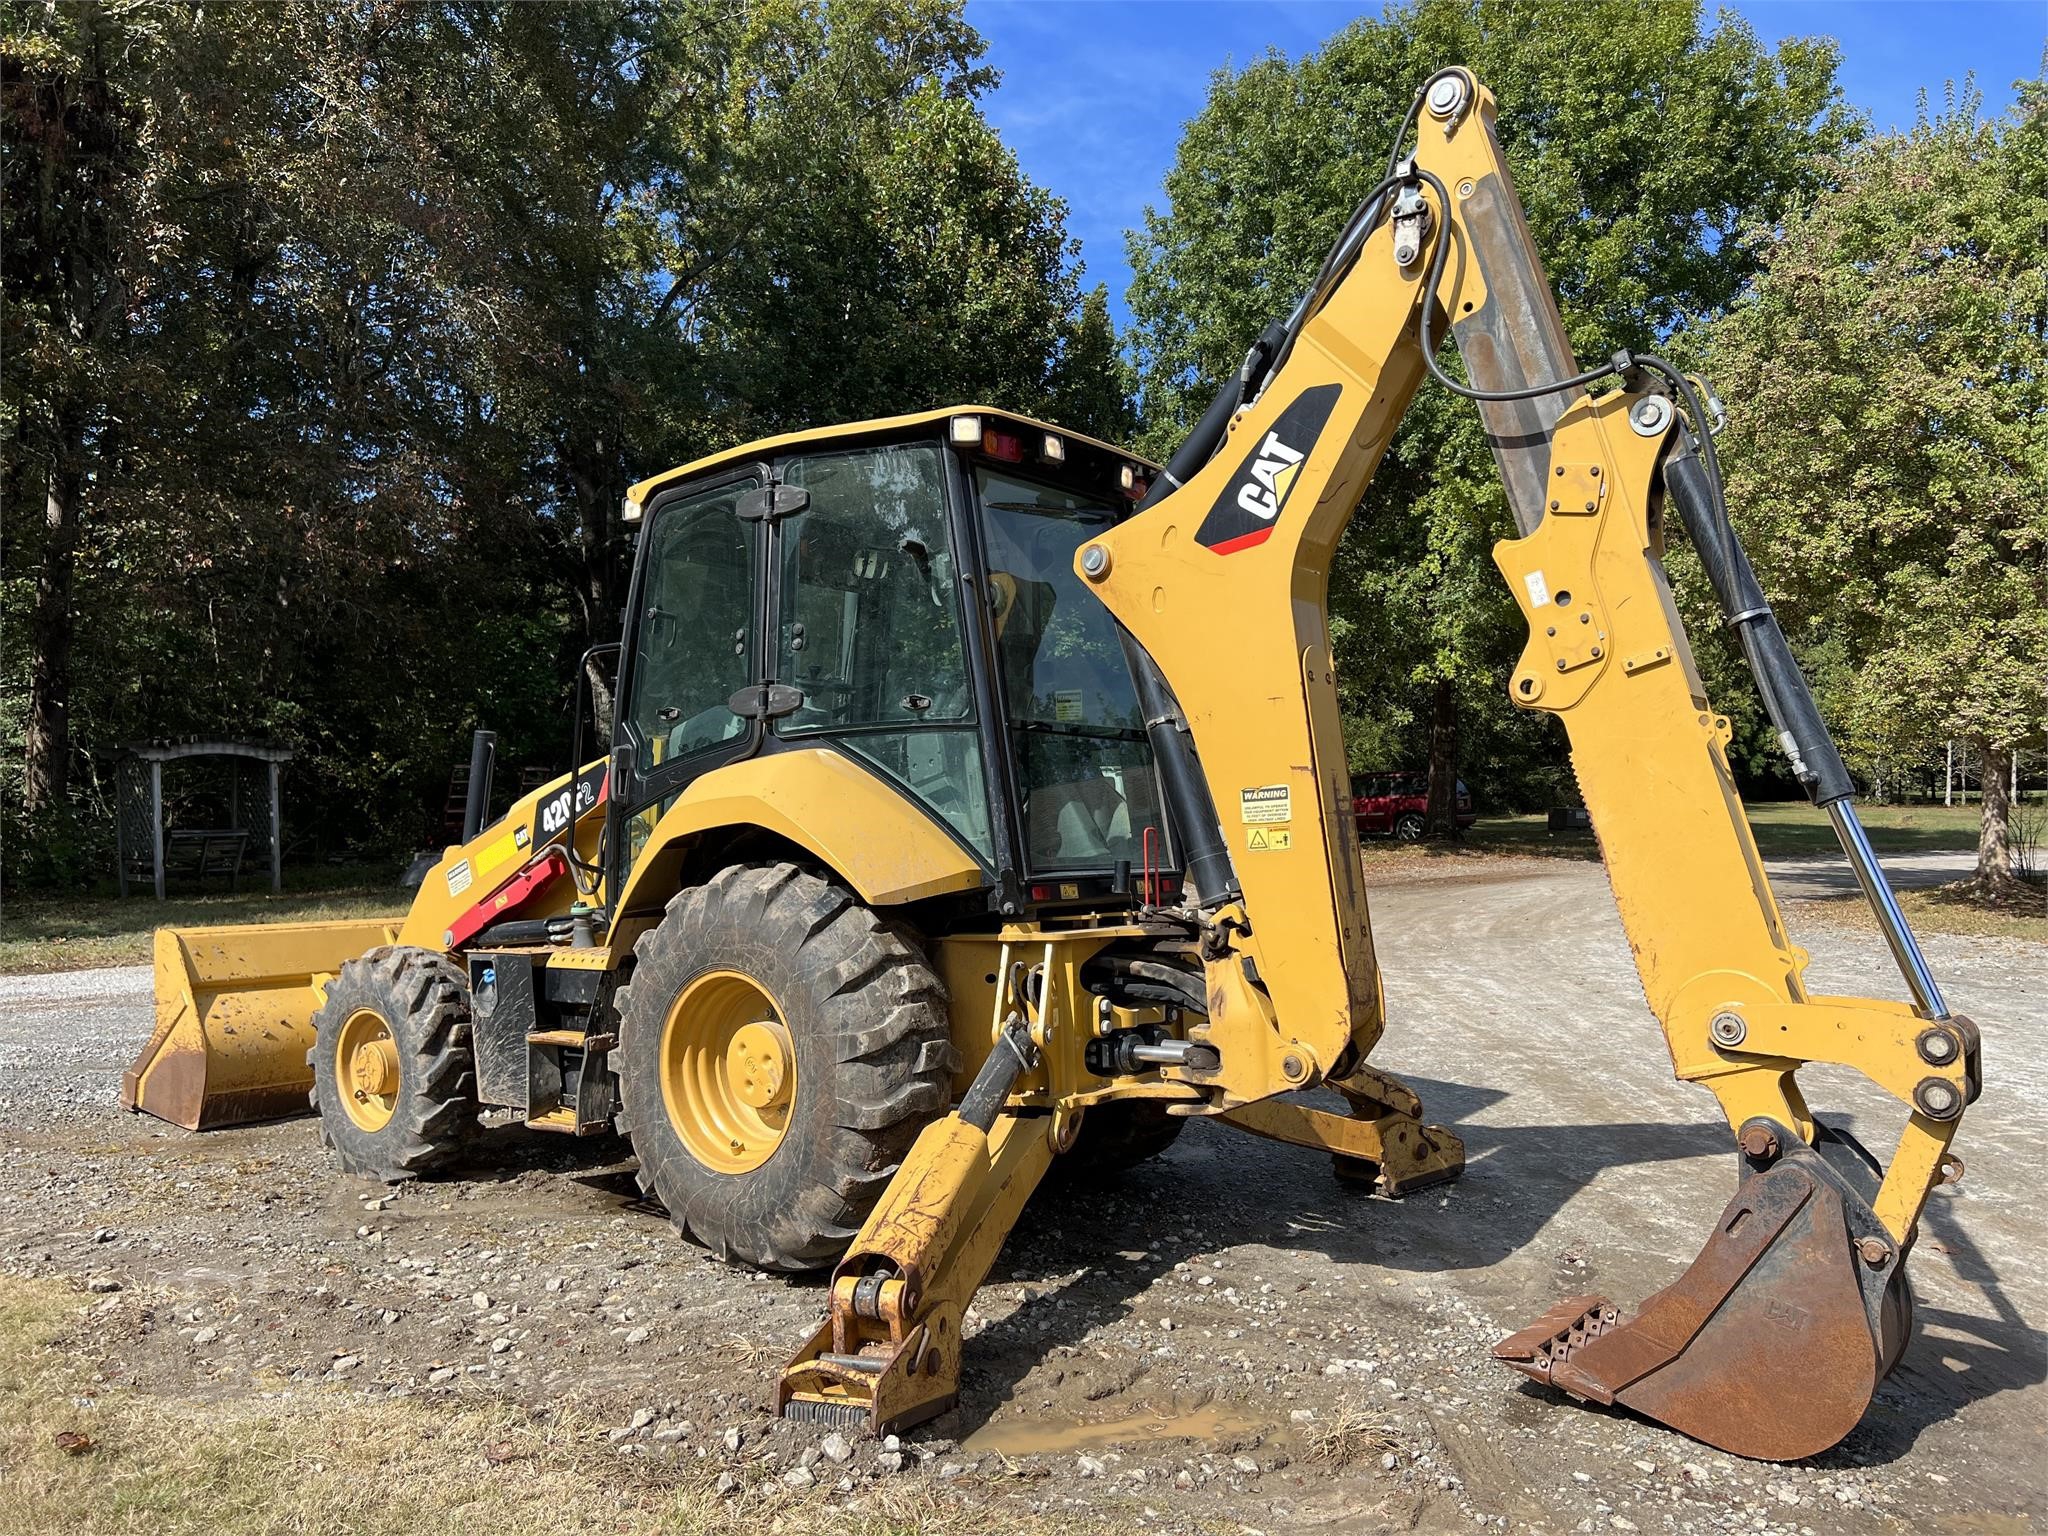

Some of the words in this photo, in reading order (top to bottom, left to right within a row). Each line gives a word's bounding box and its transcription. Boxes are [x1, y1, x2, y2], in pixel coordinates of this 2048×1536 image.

[1237, 430, 1305, 520] CAT
[1243, 788, 1287, 801] WARNING
[515, 828, 529, 847] CAT
